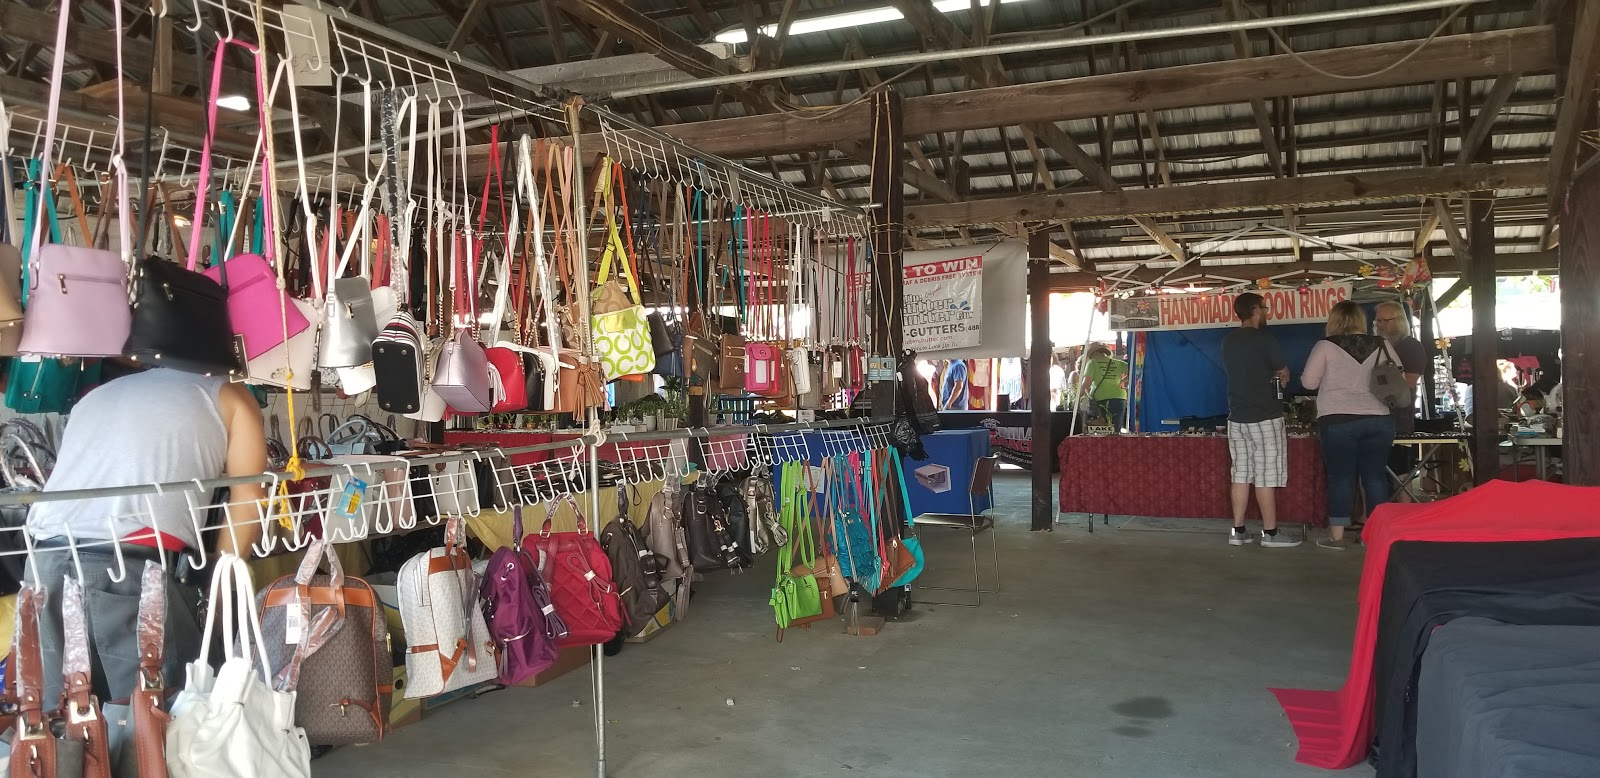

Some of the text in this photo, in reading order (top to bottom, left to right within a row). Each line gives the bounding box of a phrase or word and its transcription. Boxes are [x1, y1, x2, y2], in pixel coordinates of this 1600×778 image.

[912, 264, 937, 277] TO
[941, 258, 978, 273] WIN
[920, 275, 941, 284] DEBRIS
[942, 273, 956, 281] FREE
[903, 298, 954, 314] utter
